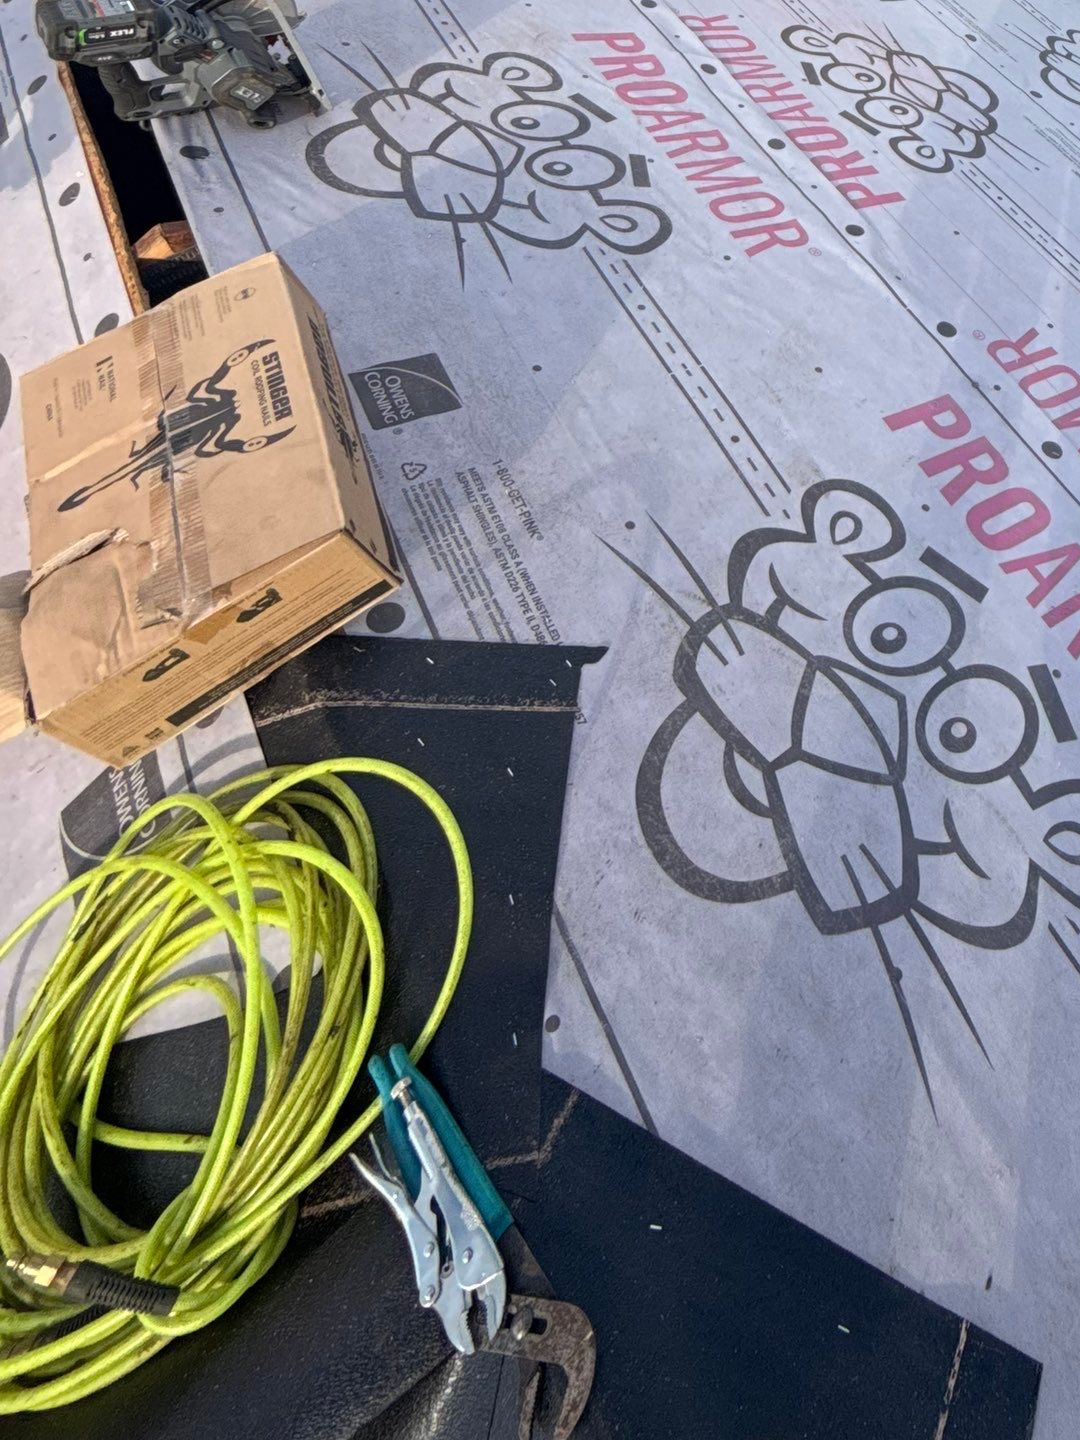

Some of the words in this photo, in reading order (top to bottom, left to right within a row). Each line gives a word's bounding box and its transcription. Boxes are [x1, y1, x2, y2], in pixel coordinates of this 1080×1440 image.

[679, 14, 906, 212] PROARMOR
[250, 359, 261, 377] COIL
[253, 376, 267, 407] ROOFING
[262, 350, 293, 422] STINGER
[364, 371, 400, 425] CORNING
[384, 375, 415, 420] OWENS
[260, 406, 272, 428] NAILS
[454, 470, 479, 505] ASPHALT
[491, 546, 511, 572] ASTM
[503, 570, 521, 594] D226
[514, 591, 533, 616] TYPE
[467, 466, 487, 494] MEETS
[499, 532, 520, 561] CLASS
[531, 595, 562, 642] INSTALLED
[129, 759, 156, 839] CORNIN
